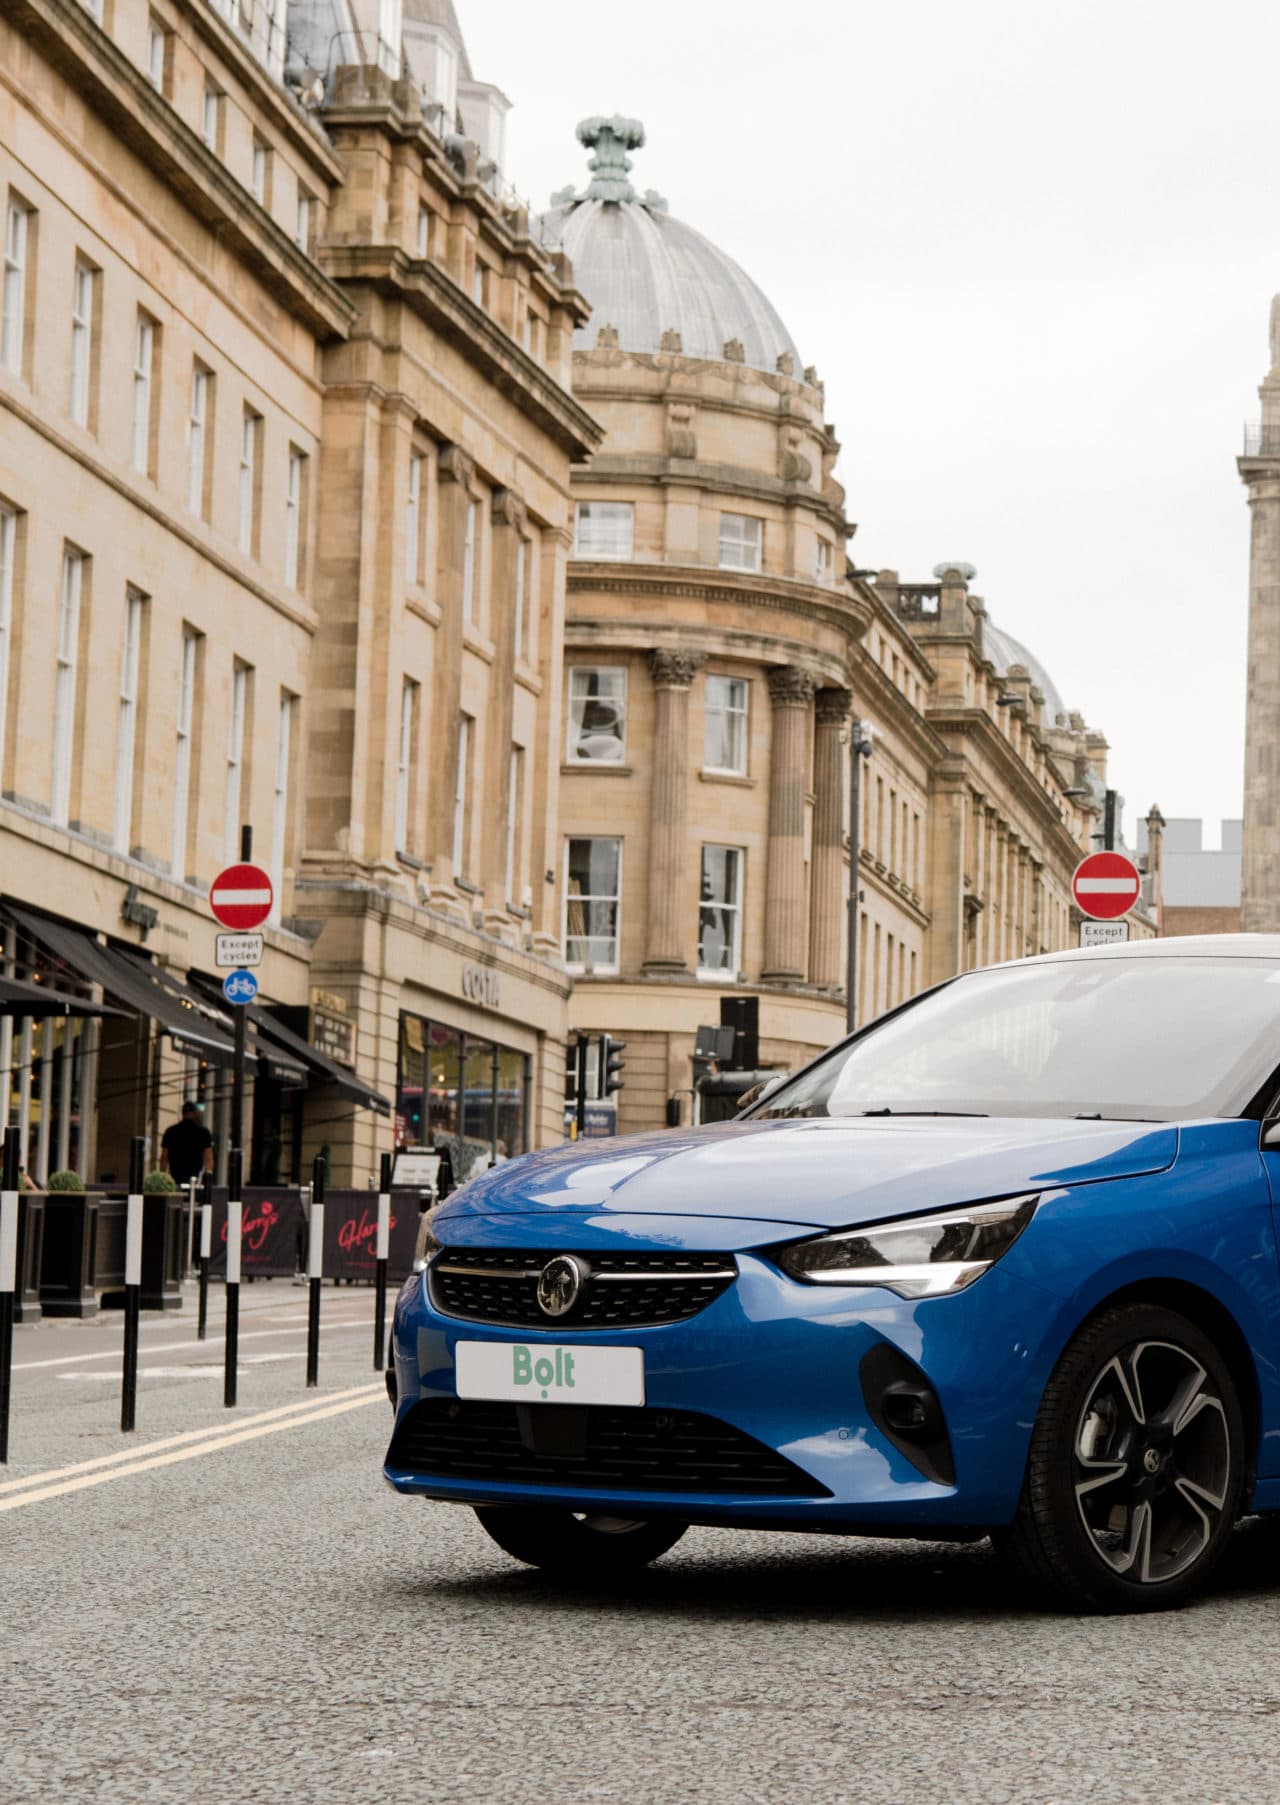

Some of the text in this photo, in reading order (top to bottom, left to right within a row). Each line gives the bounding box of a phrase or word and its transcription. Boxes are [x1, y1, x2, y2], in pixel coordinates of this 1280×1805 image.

[1086, 927, 1122, 937] Except
[221, 940, 258, 949] Except
[223, 951, 258, 962] cycles
[512, 1345, 575, 1399] Bolt
